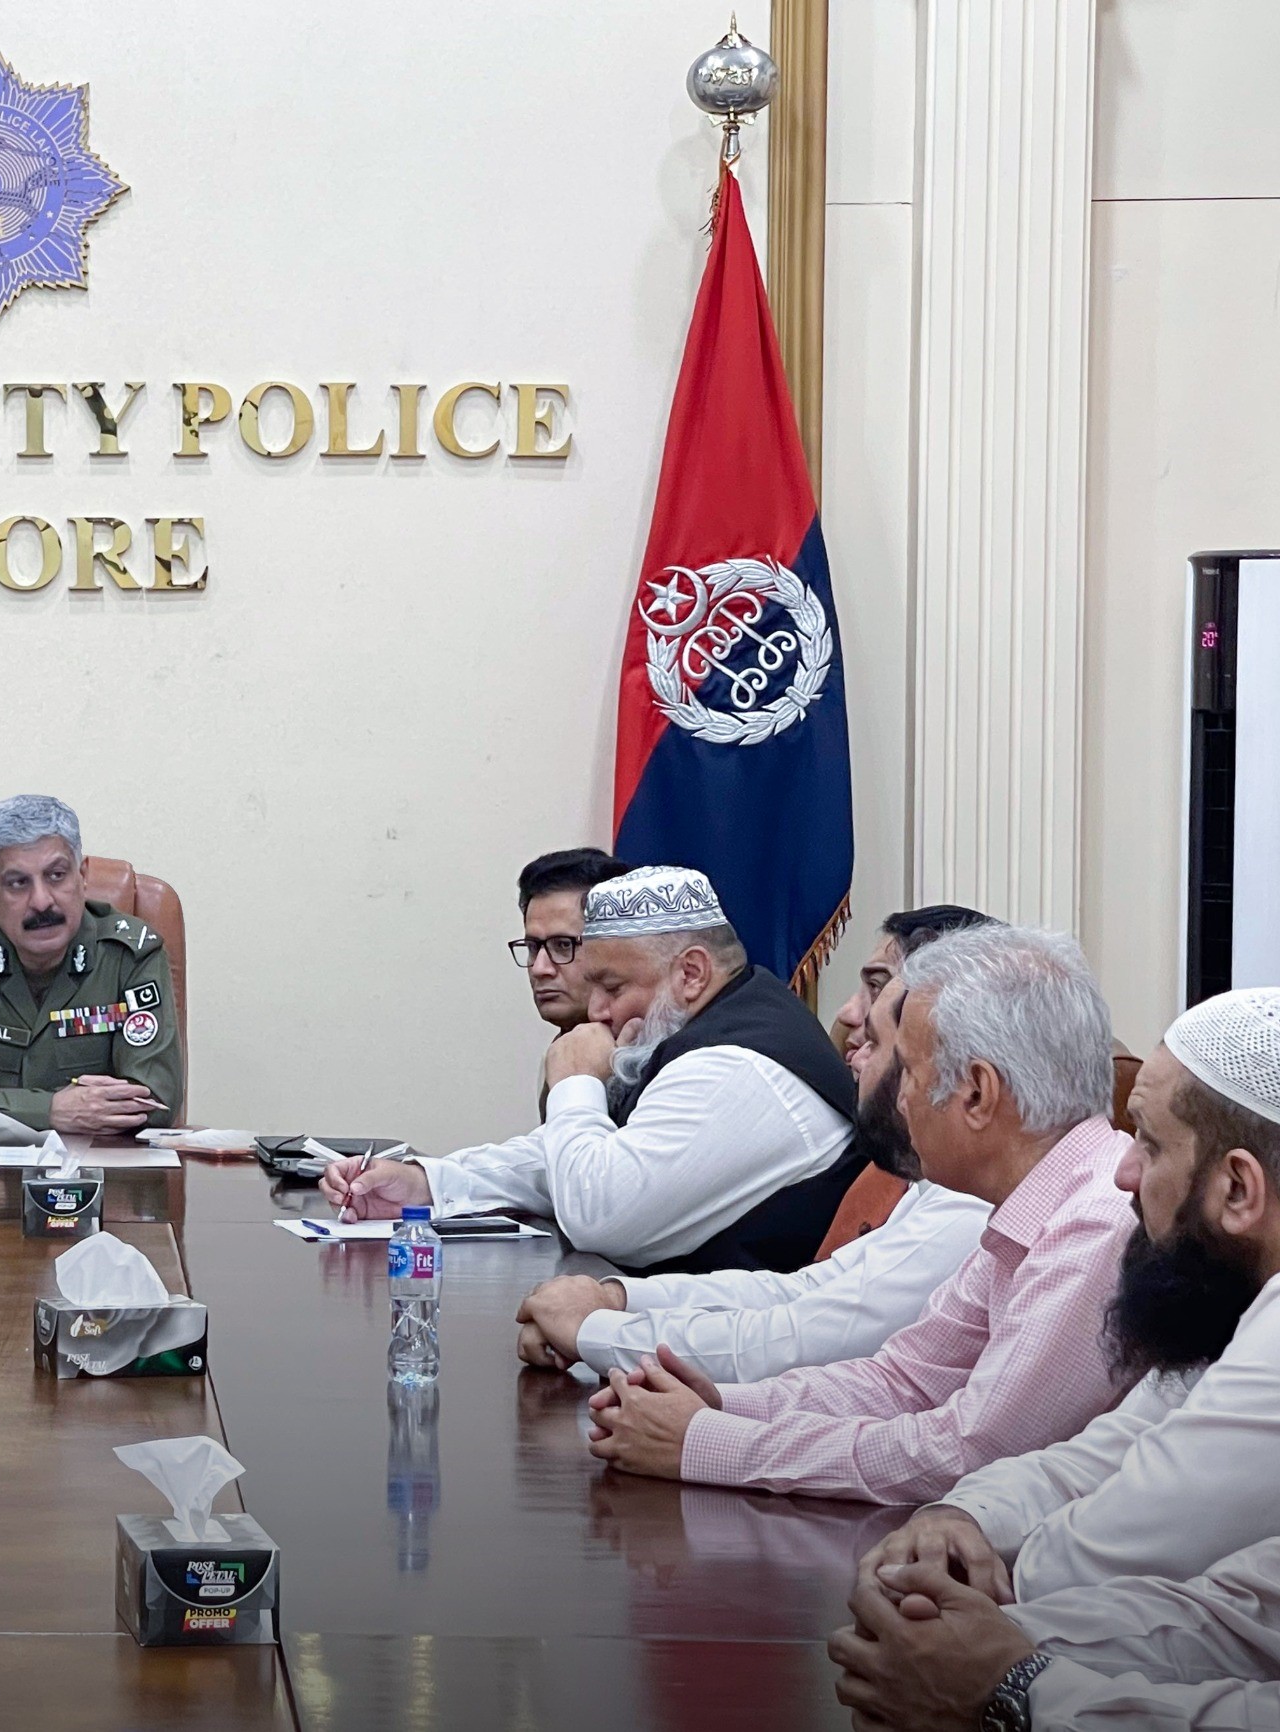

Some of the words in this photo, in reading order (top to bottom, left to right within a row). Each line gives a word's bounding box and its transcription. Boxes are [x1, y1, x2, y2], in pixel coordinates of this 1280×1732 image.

[173, 380, 573, 458] POLICE
[416, 1253, 433, 1267] fit
[84, 1325, 102, 1336] Soft
[187, 1561, 216, 1575] ROSE
[201, 1570, 235, 1580] PETAL
[189, 1609, 231, 1617] PROMO
[189, 1619, 230, 1629] OFFER
